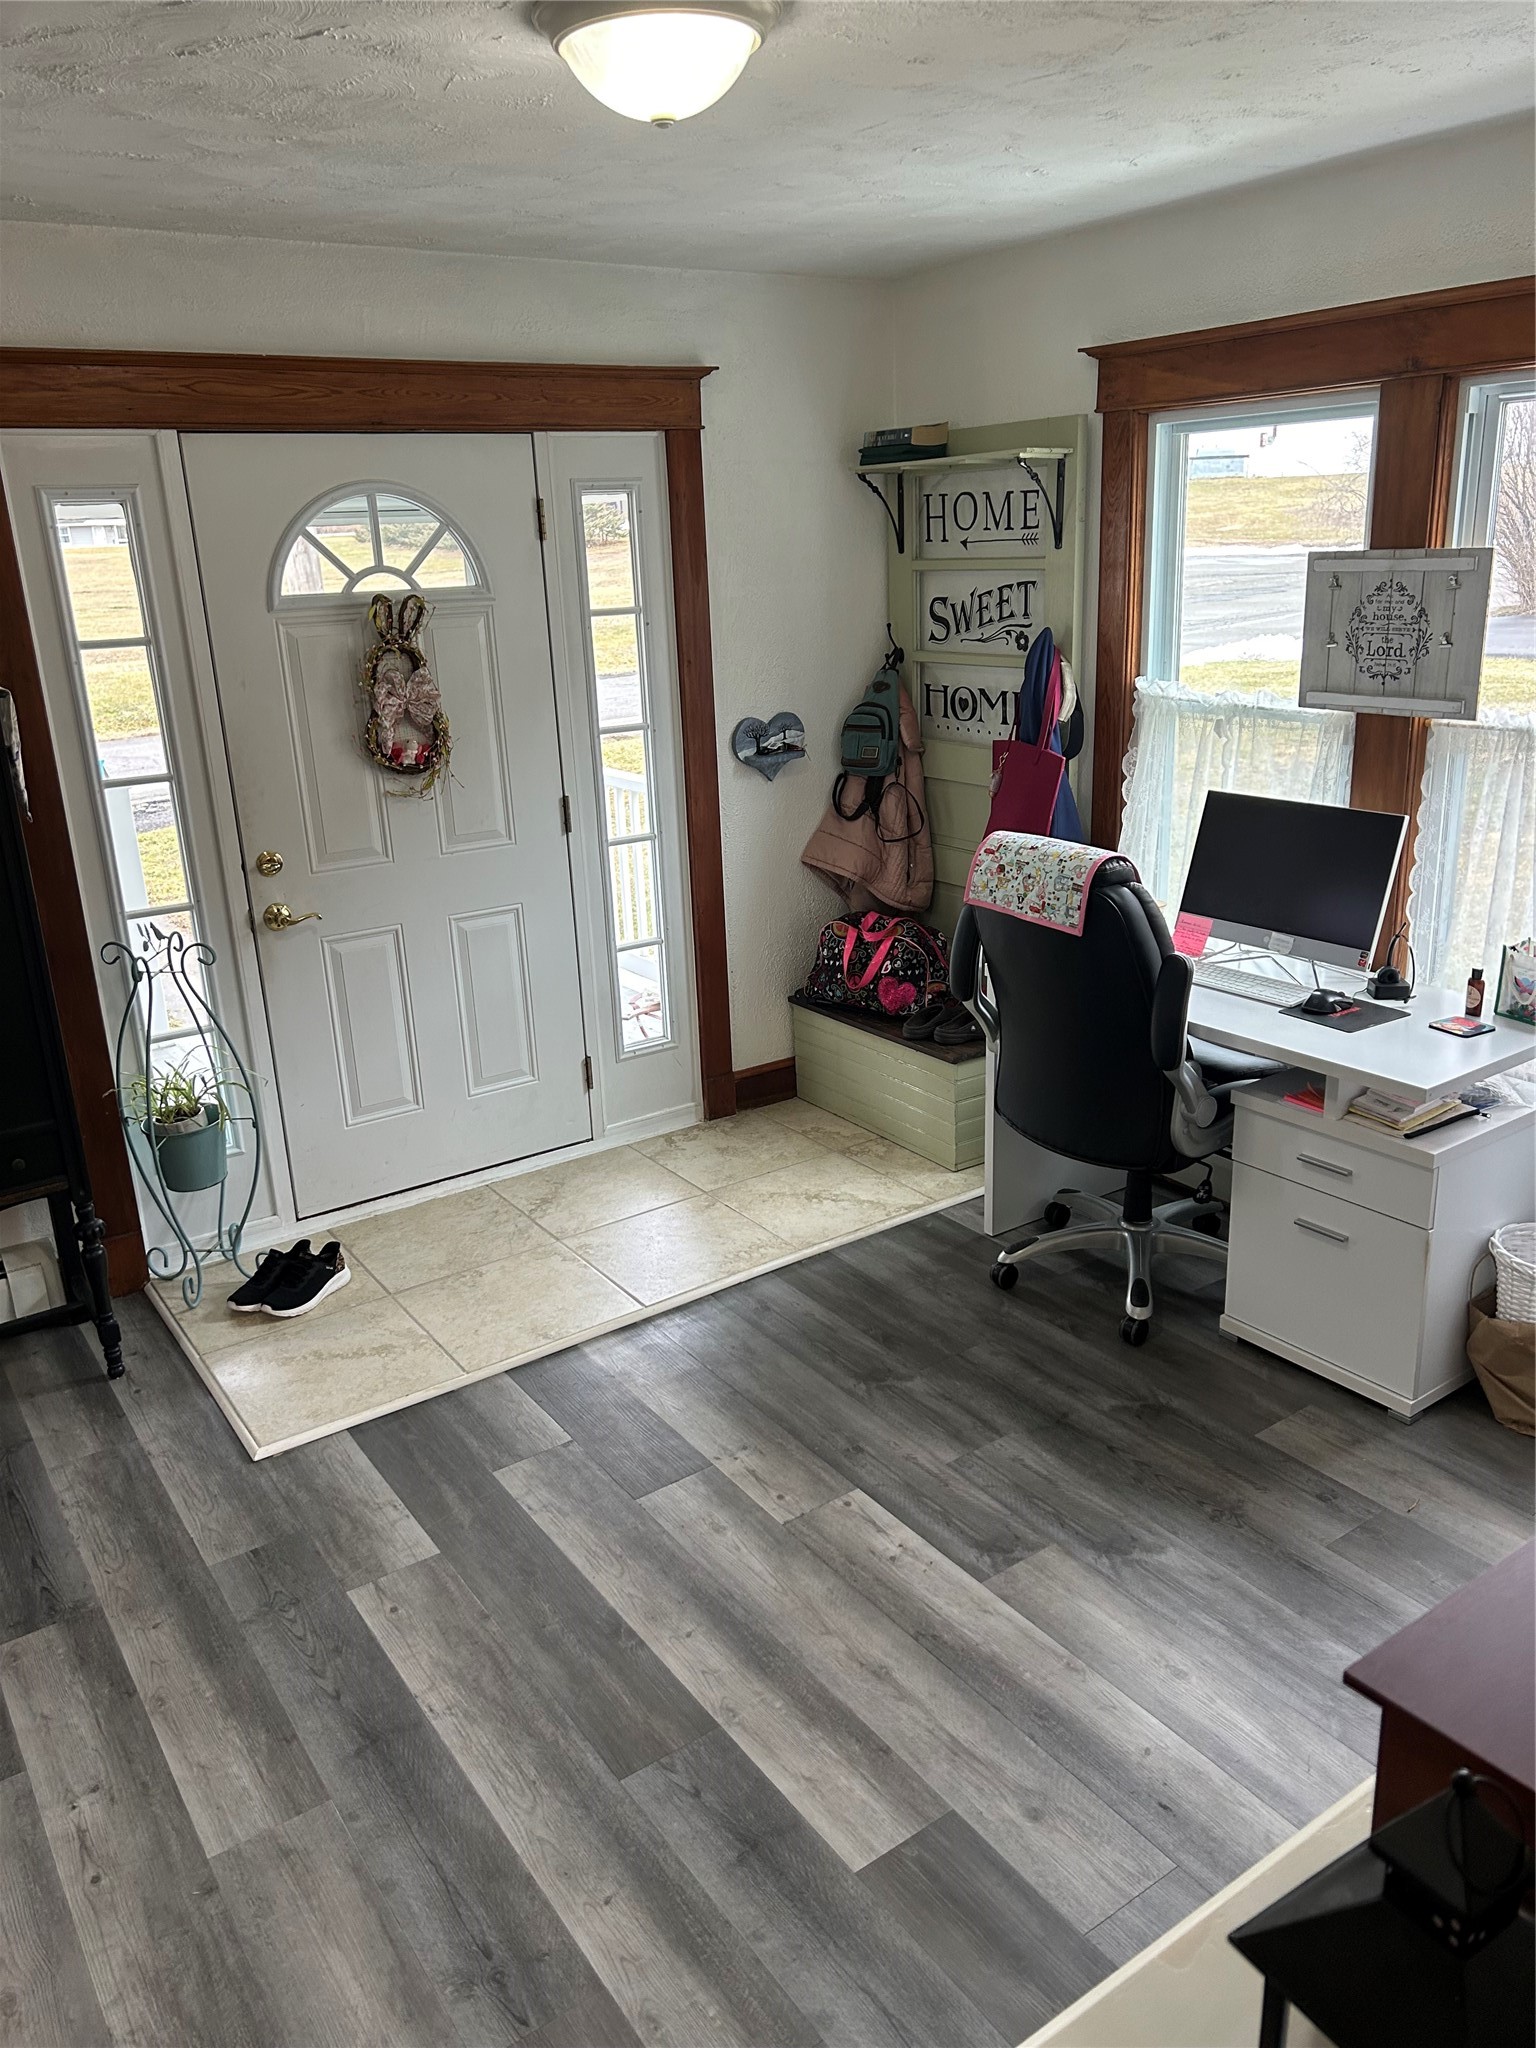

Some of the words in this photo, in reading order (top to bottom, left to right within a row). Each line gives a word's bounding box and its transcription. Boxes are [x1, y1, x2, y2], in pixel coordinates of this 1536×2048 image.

[923, 489, 1040, 543] HOME
[928, 580, 1037, 645] SWEET
[1382, 605, 1397, 615] my
[1381, 635, 1394, 644] the
